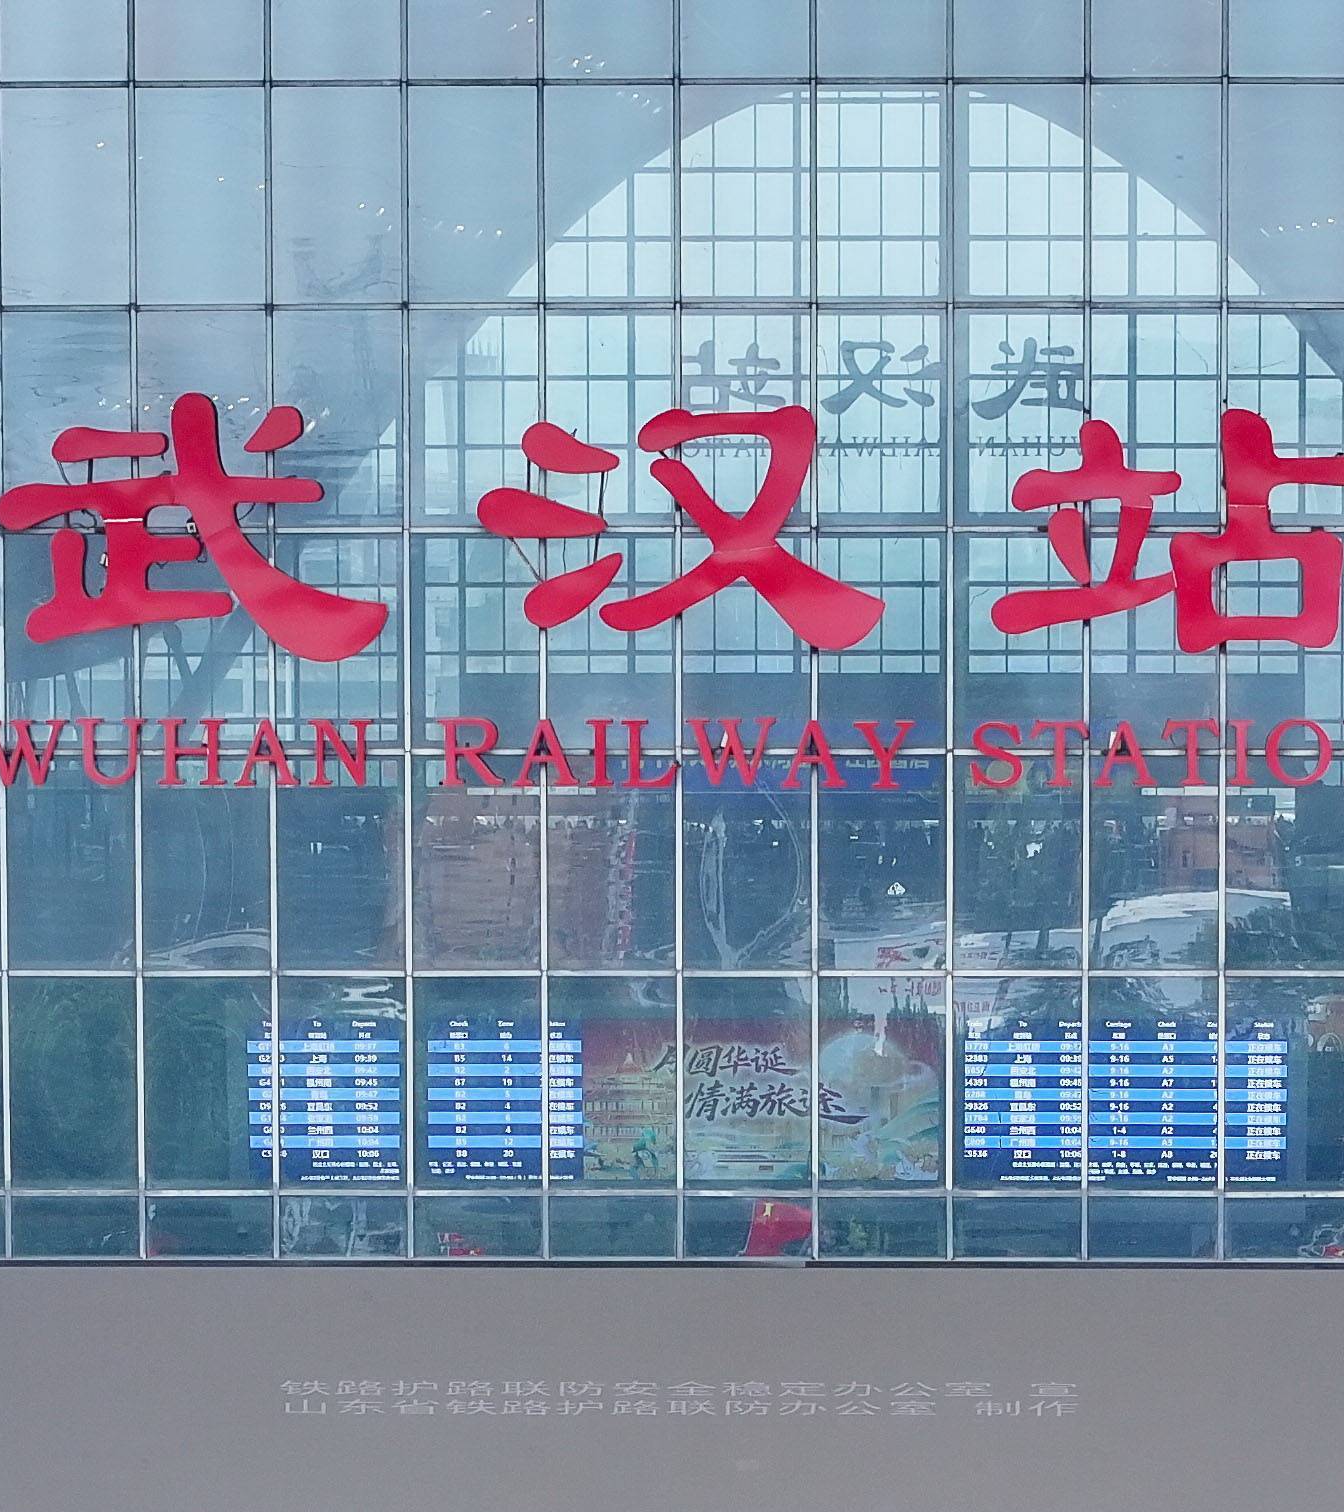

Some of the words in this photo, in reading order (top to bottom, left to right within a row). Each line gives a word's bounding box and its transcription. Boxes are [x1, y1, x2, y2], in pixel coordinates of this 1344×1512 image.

[437, 718, 914, 788] RAILWAY
[284, 1399, 936, 1416] 山东省铁路护路联防办公室
[975, 1400, 1079, 1416] 制作
